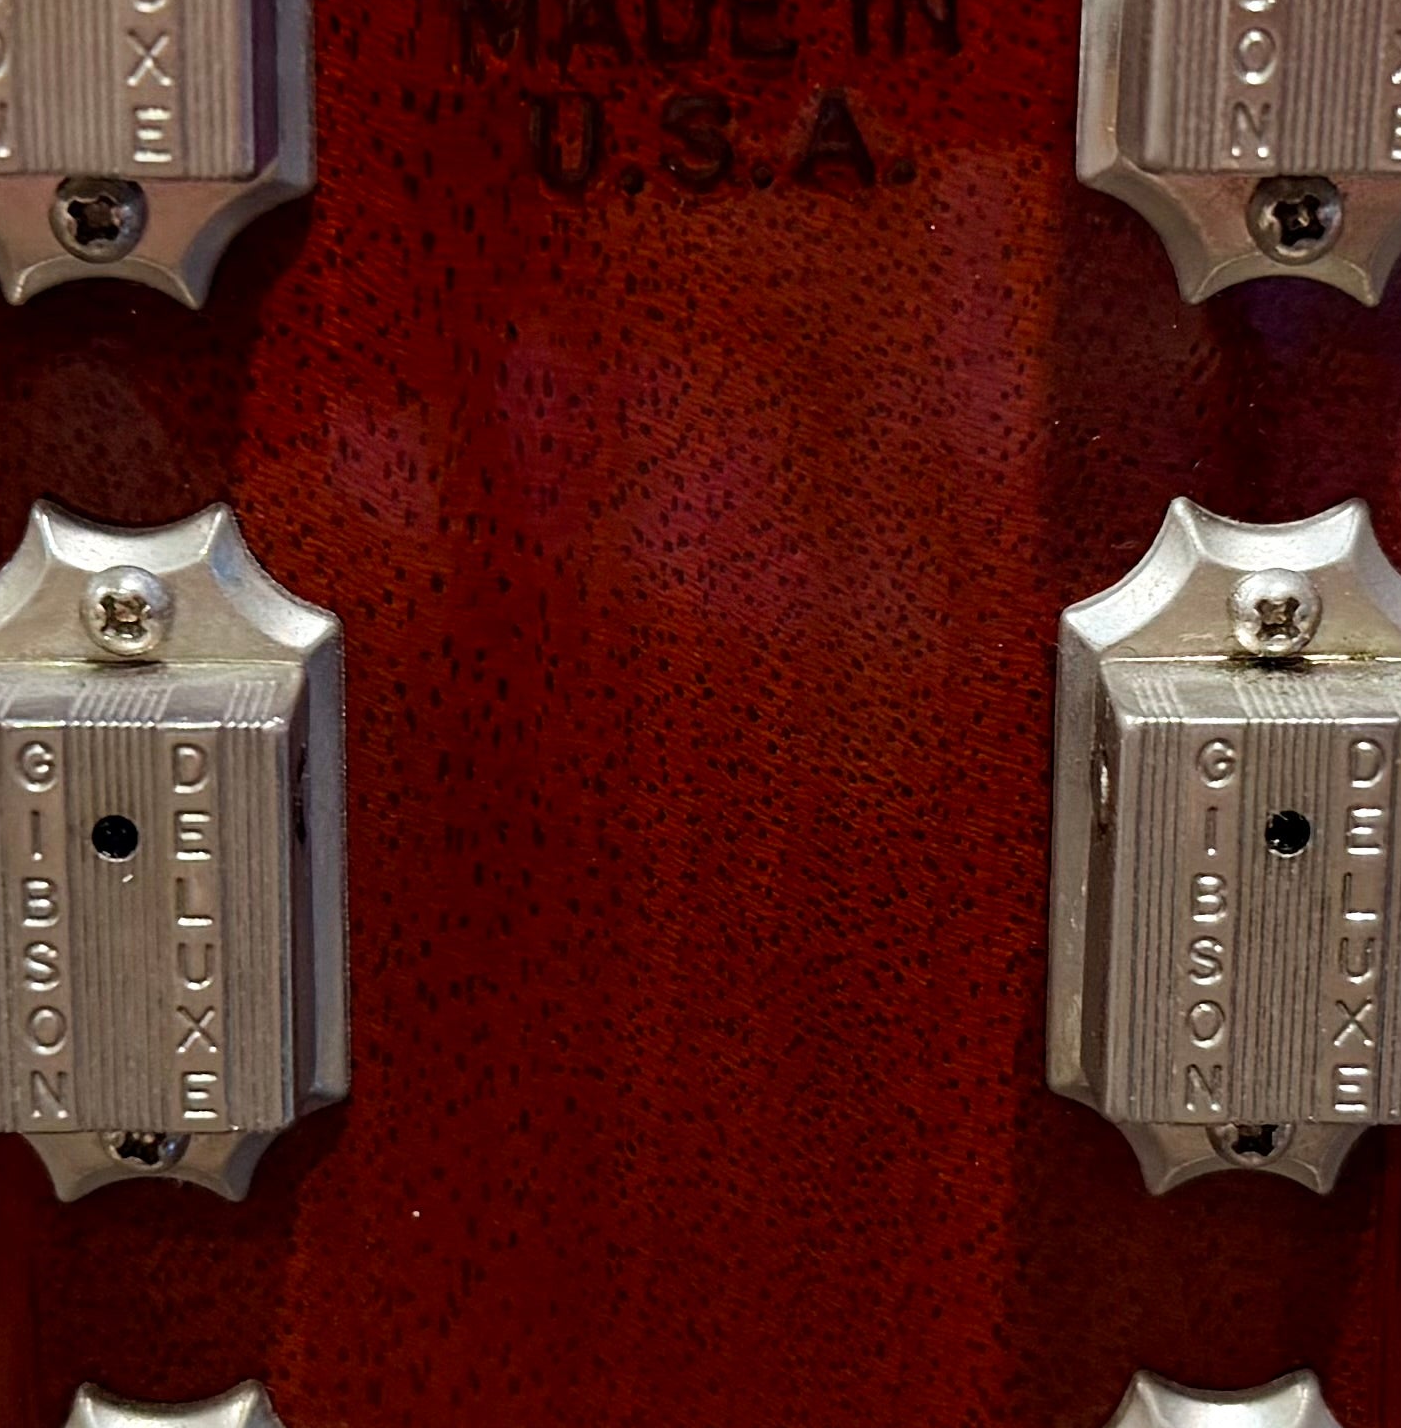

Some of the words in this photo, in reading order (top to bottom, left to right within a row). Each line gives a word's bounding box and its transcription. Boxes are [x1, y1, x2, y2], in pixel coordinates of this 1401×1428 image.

[527, 87, 919, 194] U.S.A.
[15, 738, 69, 1121] GIBSON
[171, 742, 220, 1121] DELUXE
[1183, 737, 1237, 1115] GIBSON
[1332, 737, 1386, 1114] DELUXE
